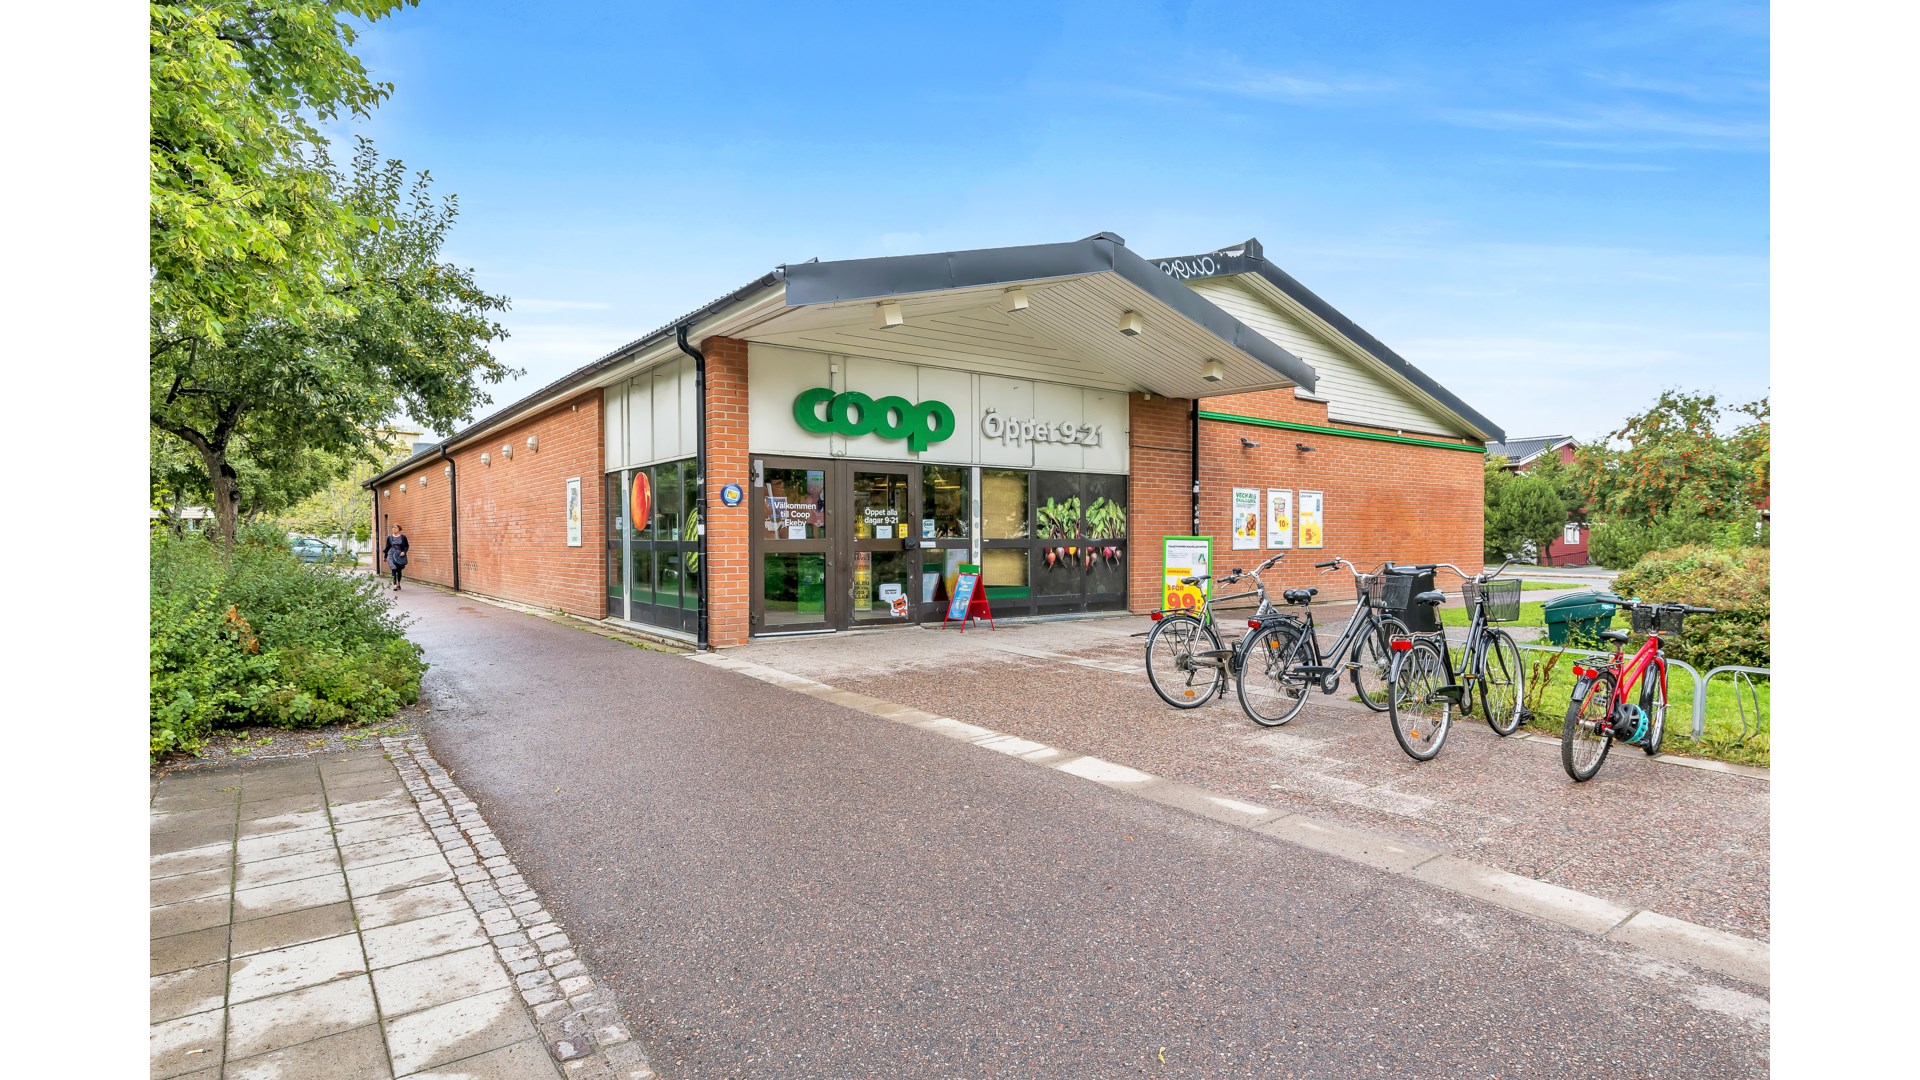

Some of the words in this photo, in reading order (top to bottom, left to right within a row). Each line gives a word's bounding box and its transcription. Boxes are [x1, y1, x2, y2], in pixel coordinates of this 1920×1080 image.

[793, 387, 956, 452] coop
[981, 407, 1058, 448] Öppet
[1059, 420, 1103, 448] 9-21
[774, 501, 816, 510] Välkommen
[790, 511, 810, 519] Coop
[864, 507, 886, 517] Öppet
[886, 508, 898, 516] alla
[864, 517, 884, 525] dagar
